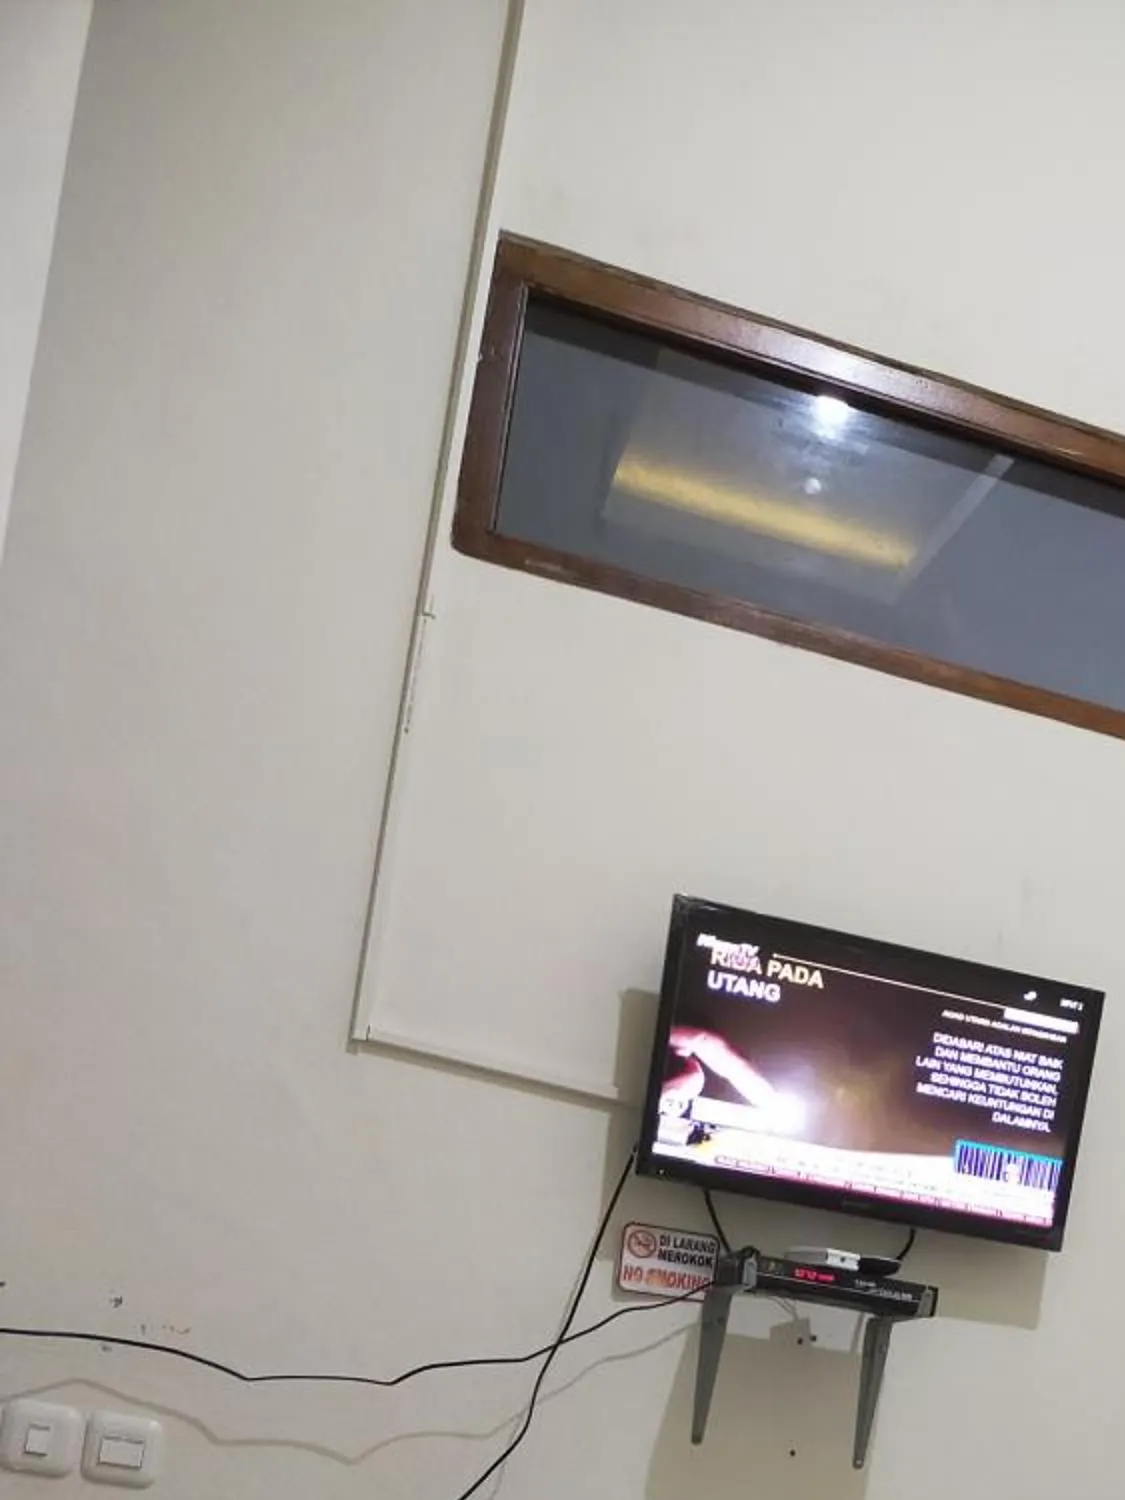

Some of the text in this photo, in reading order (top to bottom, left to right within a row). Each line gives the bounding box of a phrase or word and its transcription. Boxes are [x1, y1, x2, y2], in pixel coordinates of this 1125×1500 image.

[767, 959, 824, 989] PADA
[707, 969, 781, 1003] UTANG
[985, 1044, 1012, 1059] ATAS
[934, 1046, 1061, 1082] DAN MEMBANTU ORANG
[943, 1061, 972, 1077] YANG
[916, 1082, 966, 1102] MENCARI
[987, 1084, 1020, 1100] TIDAK
[1021, 1091, 1057, 1107] BOLEH
[660, 1234, 716, 1254] DI LARANG
[658, 1248, 713, 1268] MEROKOK
[623, 1265, 643, 1281] NO
